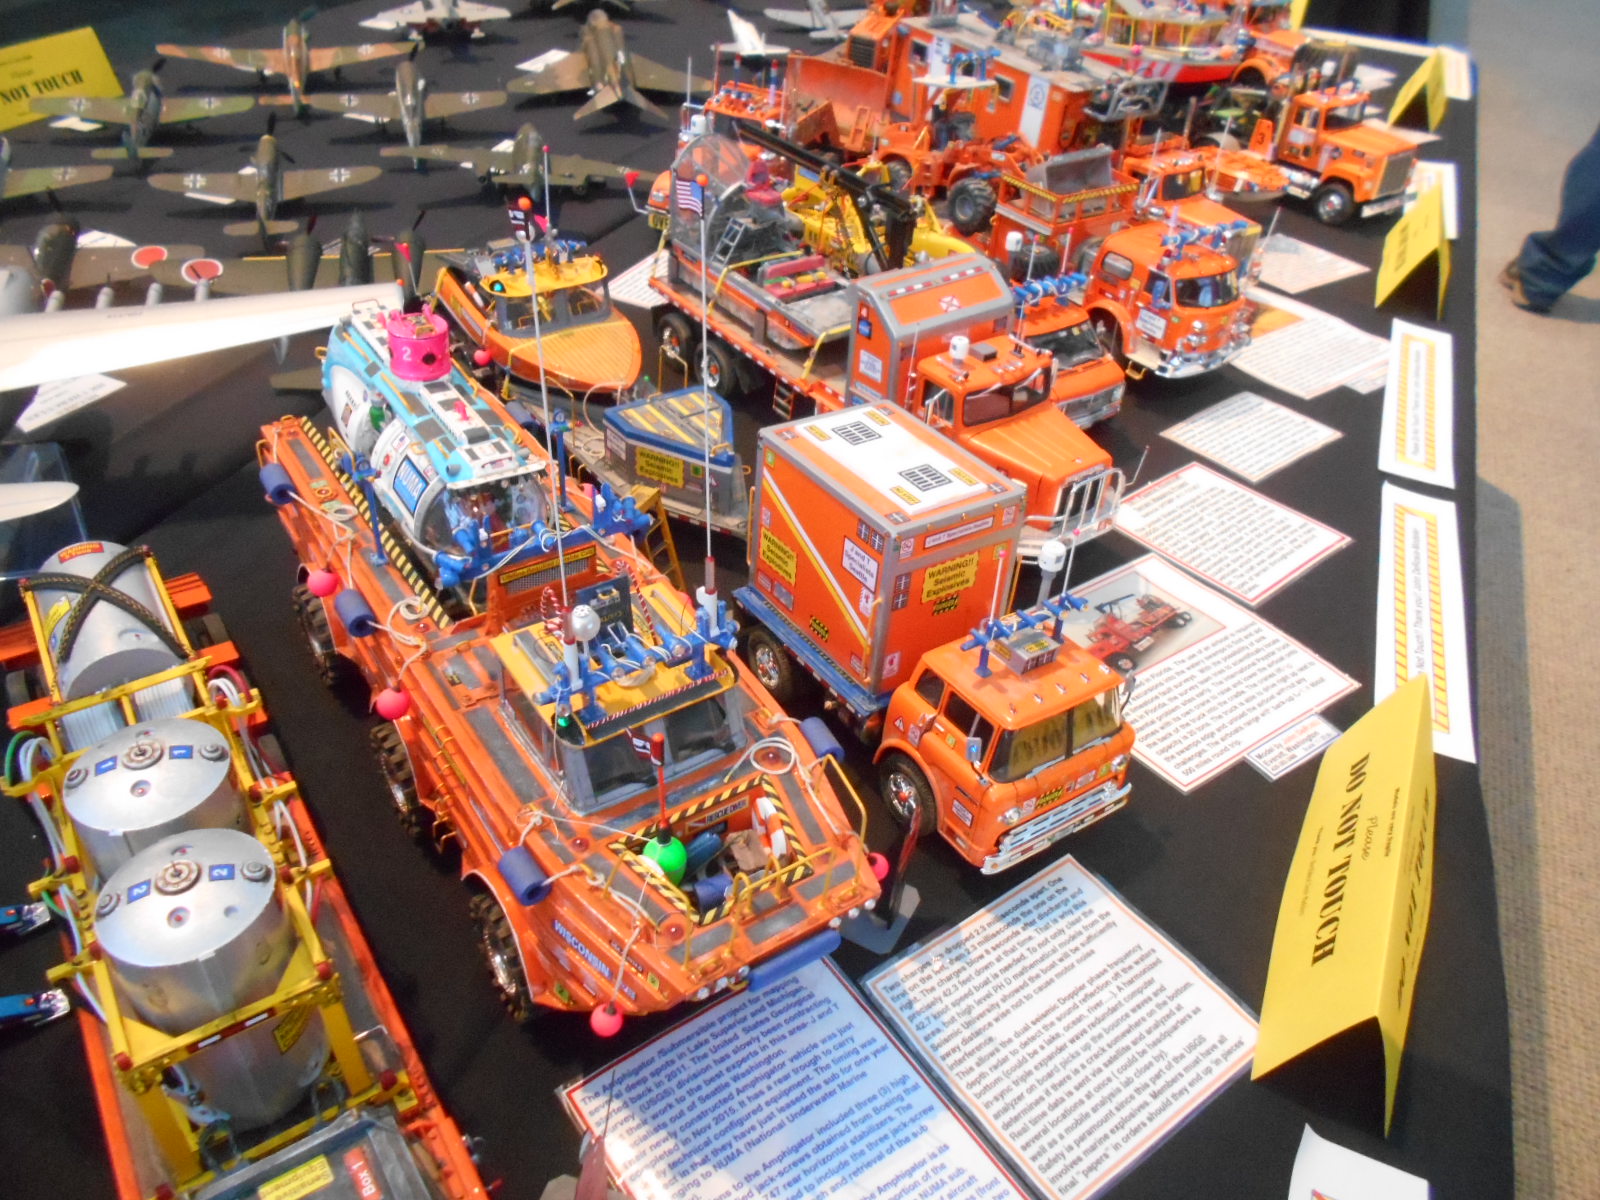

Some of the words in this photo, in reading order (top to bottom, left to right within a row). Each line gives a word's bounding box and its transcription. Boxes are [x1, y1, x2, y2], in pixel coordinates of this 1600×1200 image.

[33, 69, 83, 94] TOUCH
[401, 346, 412, 361] 2
[926, 578, 970, 599] Explosives
[928, 557, 974, 579] WARNING!!
[933, 569, 966, 587] Seismic
[1345, 752, 1371, 793] DO
[706, 806, 729, 824] RESCUE
[1333, 794, 1363, 853] NOT
[1361, 816, 1379, 861] Please
[133, 884, 148, 896] 2
[213, 868, 229, 877] 2
[1311, 854, 1352, 967] TOUCH
[554, 919, 613, 979] WISCONSIN
[716, 1003, 750, 1026] project
[747, 995, 762, 1006] for
[760, 974, 799, 1000] mapping
[628, 1085, 653, 1104] back
[653, 1079, 664, 1089] in
[664, 1063, 690, 1083] 2011.
[691, 1052, 710, 1066] The
[709, 1034, 740, 1056] United
[742, 1016, 771, 1036] States
[769, 990, 816, 1021] Geological
[638, 1087, 677, 1115] (USGS)
[675, 1064, 714, 1091] division
[712, 1053, 732, 1067] has
[730, 1035, 763, 1058] slowly
[759, 1021, 784, 1039] been
[781, 994, 830, 1026] contracting
[647, 1128, 680, 1154] newly
[678, 1093, 736, 1133] constructed
[734, 1060, 790, 1099] Amphigator
[786, 1041, 819, 1064] vehicle
[818, 1032, 837, 1045] was
[834, 1020, 854, 1036] just
[1008, 1123, 1031, 1142] Real
[1027, 1109, 1049, 1127] time
[1045, 1095, 1067, 1113] data
[1071, 1075, 1092, 1092] sent
[1100, 1043, 1132, 1069] satellite
[1142, 1009, 1178, 1037] analyzed
[666, 1108, 685, 1124] out
[684, 1100, 698, 1113] of
[696, 1080, 731, 1105] Seattle
[699, 1168, 713, 1181] to
[711, 1148, 744, 1172] NUMA
[742, 1120, 789, 1154] (National
[786, 1088, 839, 1124] Underwater
[836, 1069, 868, 1092] Marine
[1037, 1149, 1068, 1177] Safety
[1071, 1109, 1117, 1148] paramount
[1112, 1092, 1136, 1112] since
[1132, 1080, 1151, 1096] this
[1147, 1067, 1168, 1085] part
[1182, 1034, 1207, 1055] USGS
[730, 1179, 744, 1191] to
[742, 1168, 761, 1184] the
[760, 1133, 817, 1174] Amphigator
[814, 1107, 856, 1136] included
[853, 1092, 879, 1111] three
[875, 1084, 892, 1098] (3)
[888, 1072, 911, 1090] high
[753, 1151, 814, 1195] jack-screws
[810, 1125, 852, 1155] obtained
[849, 1111, 874, 1129] from
[871, 1092, 905, 1117] Boeing
[901, 1081, 921, 1096] that
[781, 1175, 803, 1191] rear
[801, 1142, 850, 1178] horizontal
[894, 1101, 914, 1116] The
[358, 1171, 377, 1198] Box
